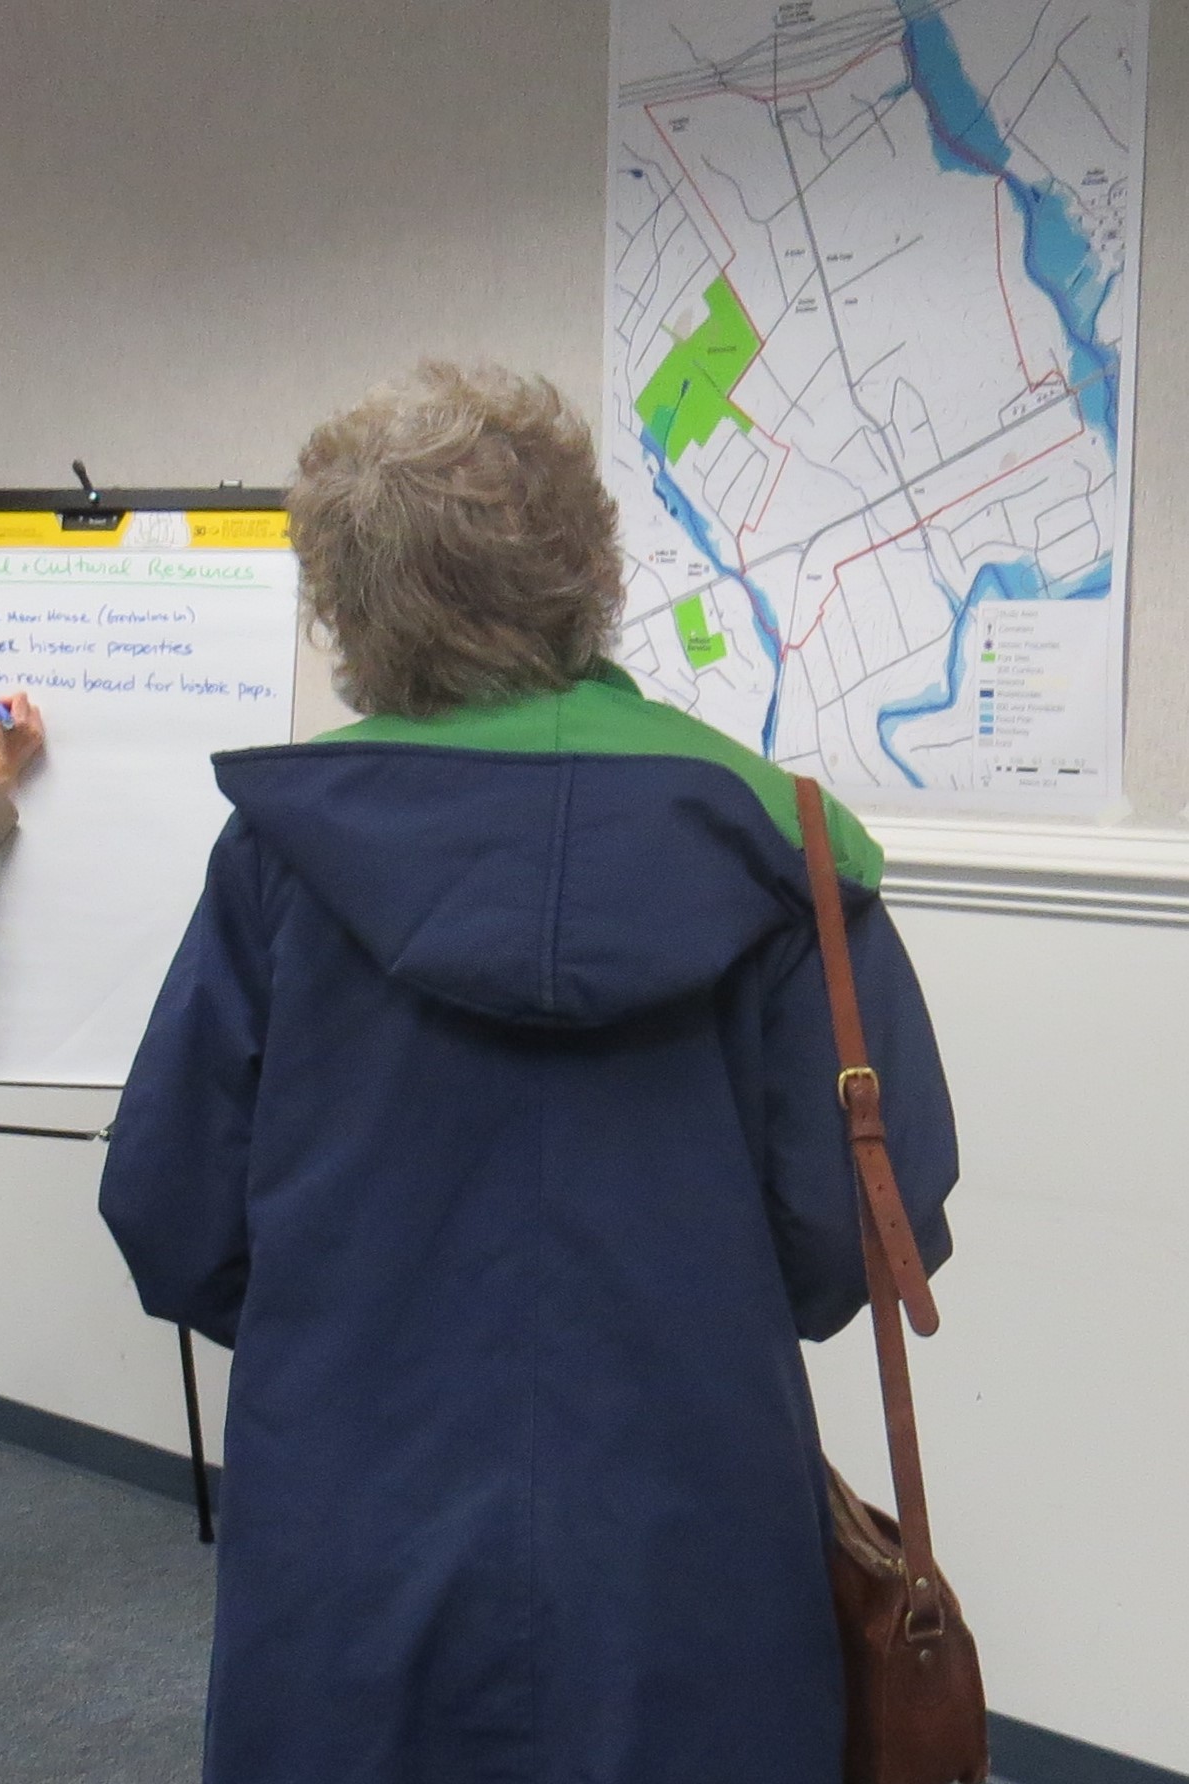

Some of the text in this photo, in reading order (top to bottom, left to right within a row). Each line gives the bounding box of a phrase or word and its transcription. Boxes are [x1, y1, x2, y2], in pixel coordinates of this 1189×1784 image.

[34, 555, 133, 576] Cultural
[147, 556, 255, 579] Resources
[29, 633, 97, 654] historic
[107, 639, 194, 657] properties
[17, 669, 76, 688] review
[83, 669, 136, 692] board
[144, 672, 173, 692] for
